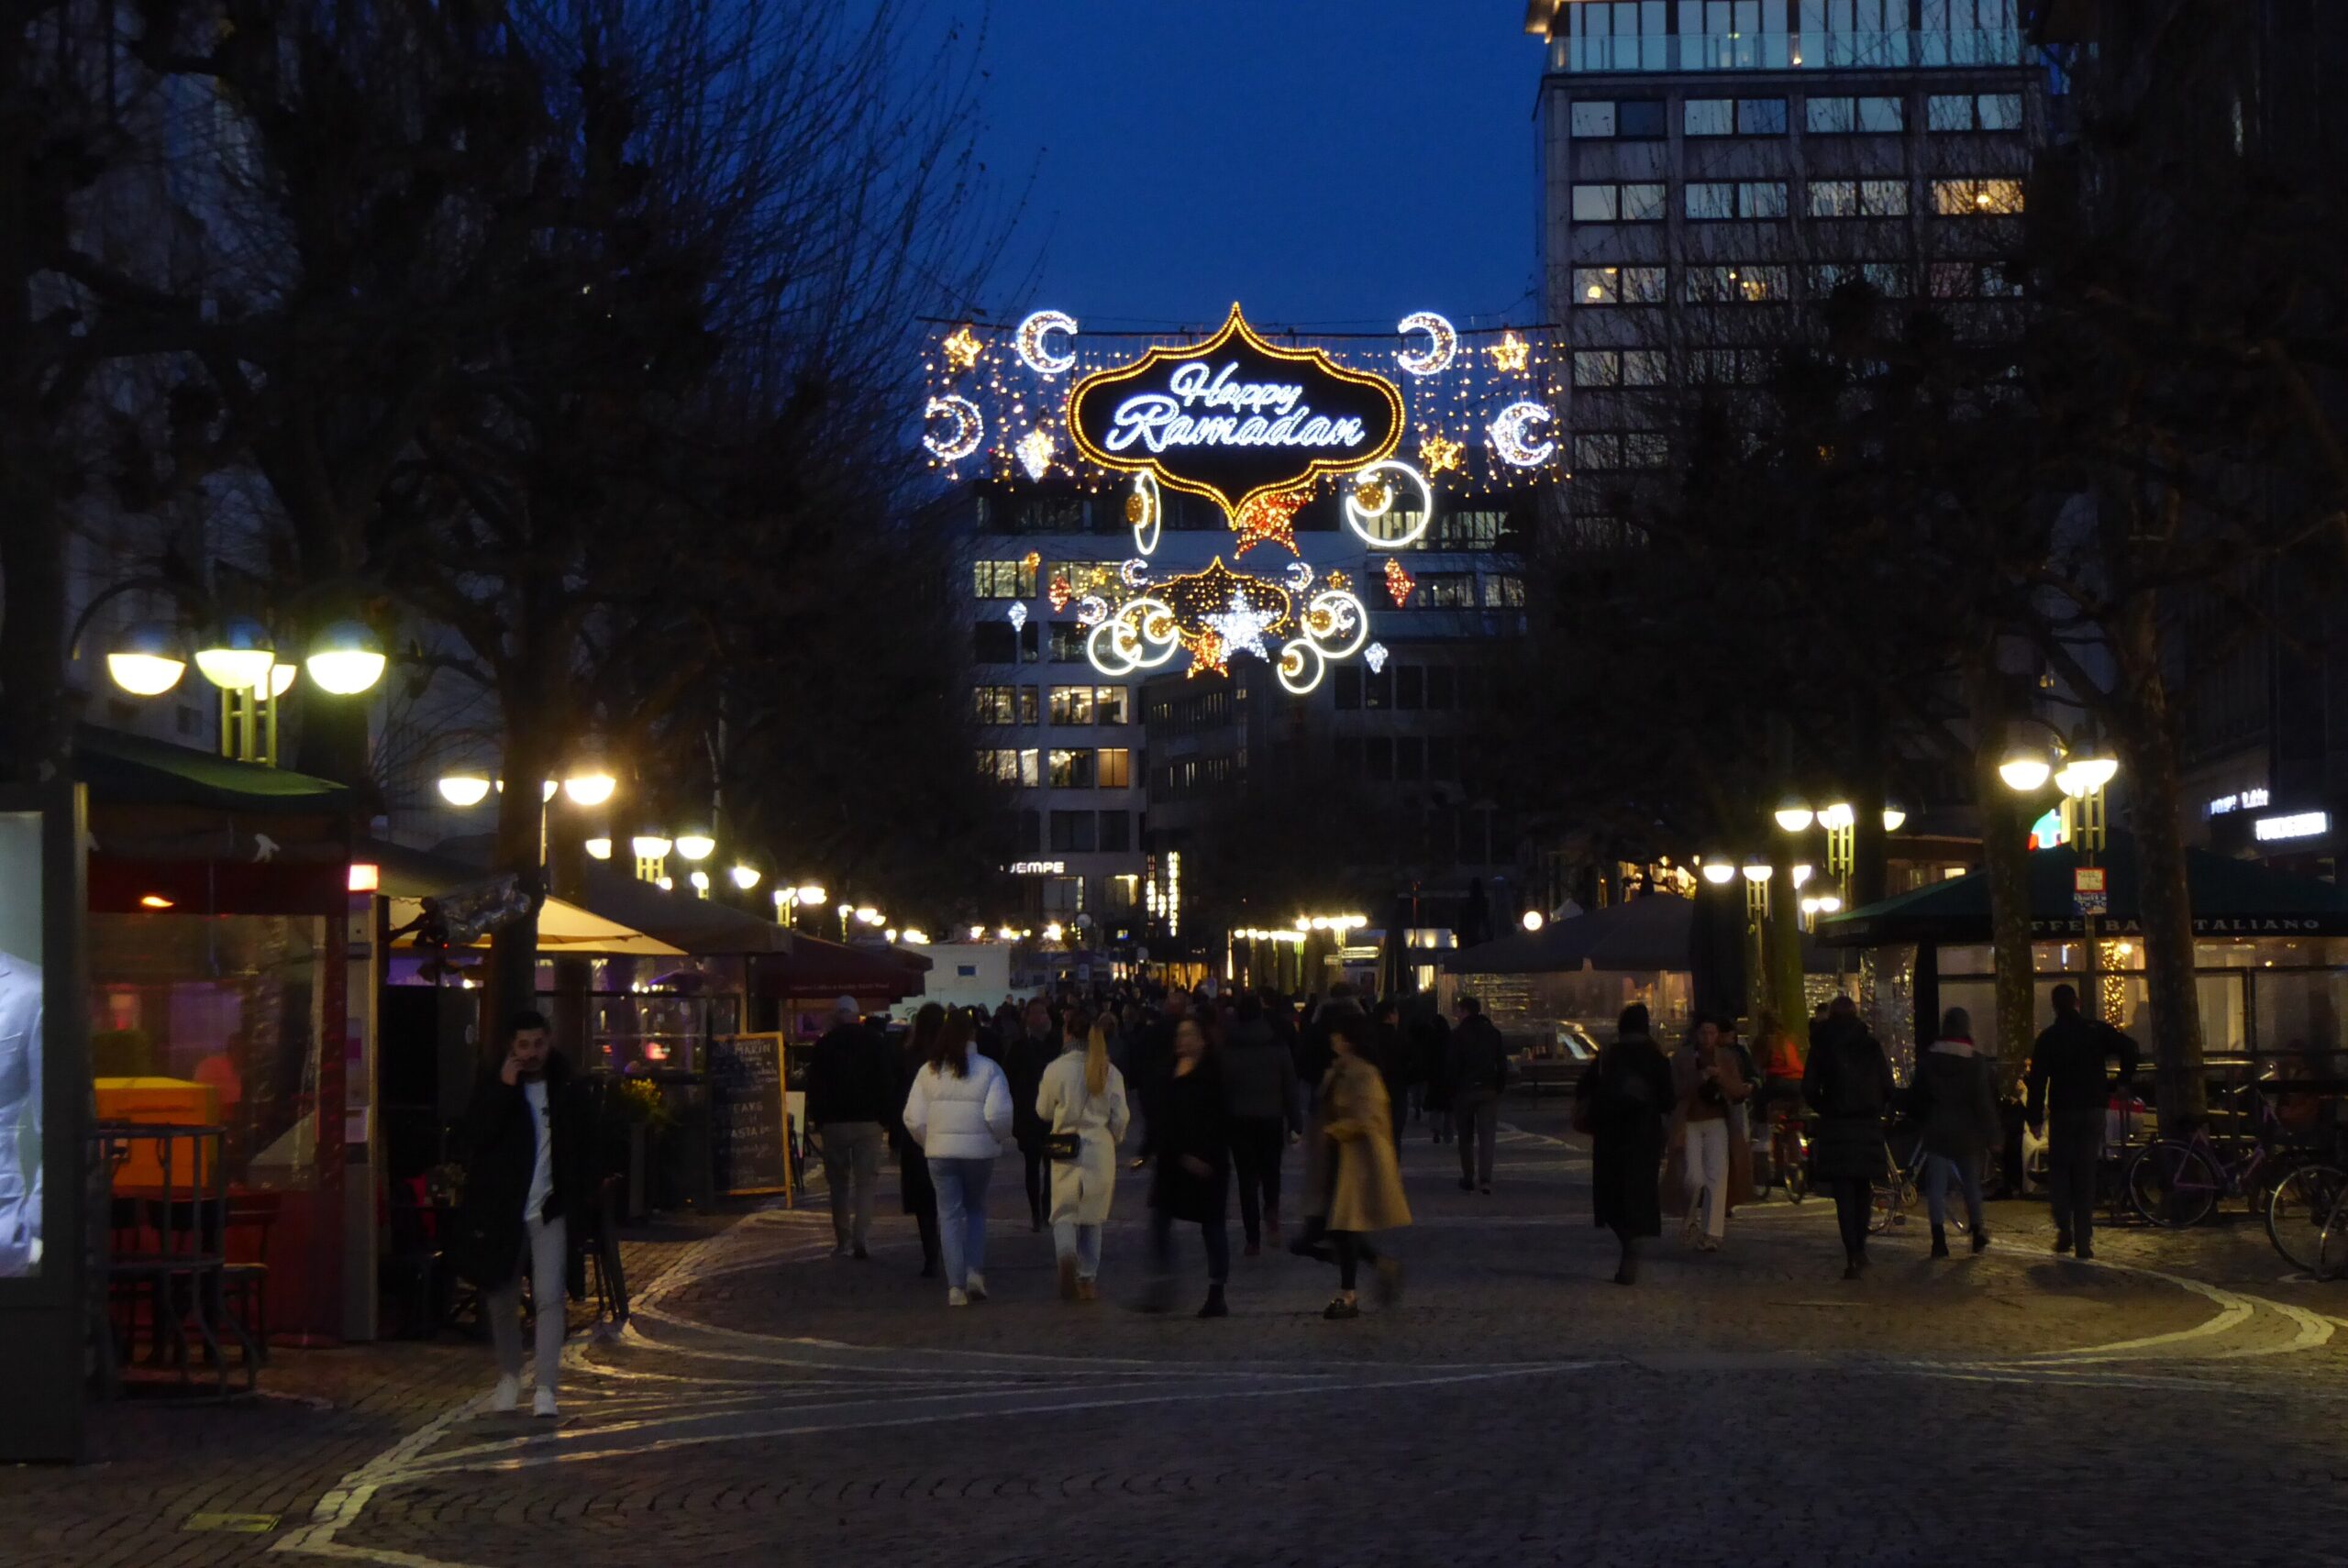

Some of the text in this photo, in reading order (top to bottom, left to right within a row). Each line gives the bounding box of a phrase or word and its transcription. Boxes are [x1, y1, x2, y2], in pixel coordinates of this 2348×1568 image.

[1170, 361, 1302, 415] Happy
[1105, 394, 1366, 453] Ramadan
[2105, 919, 2141, 932] BA
[2193, 918, 2320, 932] TALIANO
